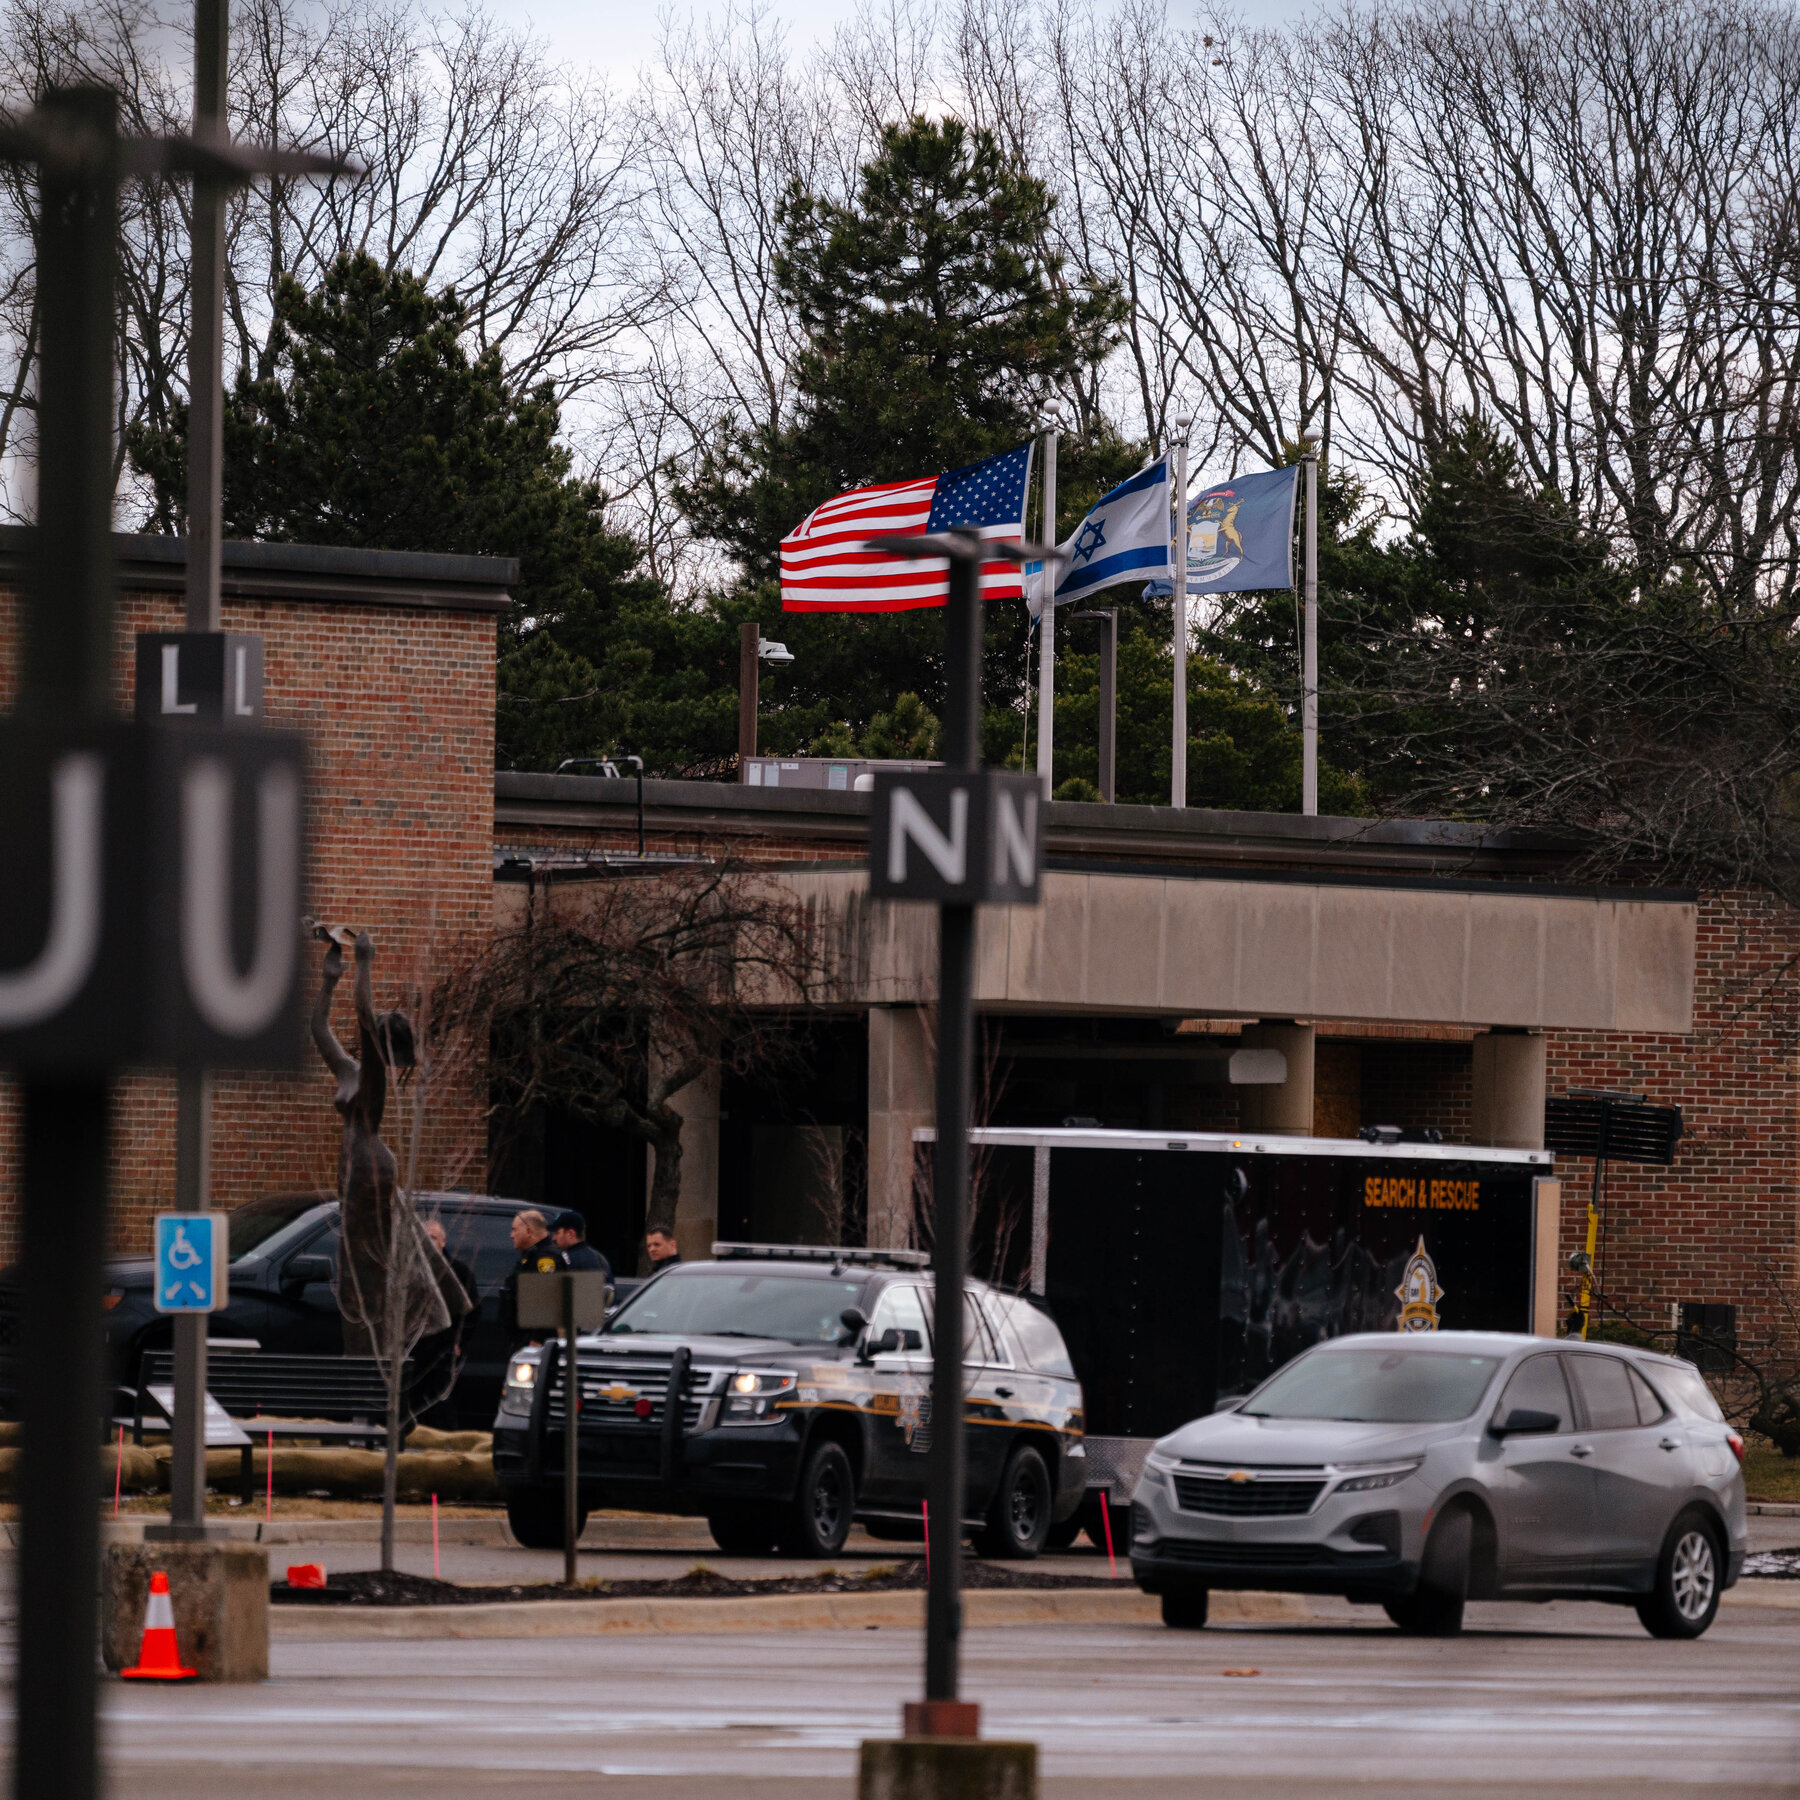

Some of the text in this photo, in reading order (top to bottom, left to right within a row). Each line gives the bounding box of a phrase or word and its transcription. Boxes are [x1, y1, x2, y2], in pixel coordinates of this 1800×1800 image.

[161, 645, 198, 714] L
[235, 646, 254, 716] L
[887, 787, 969, 884] N
[994, 790, 1038, 887] N
[180, 754, 300, 1036] U
[1365, 1177, 1480, 1209] SEARCH & RESCUE
